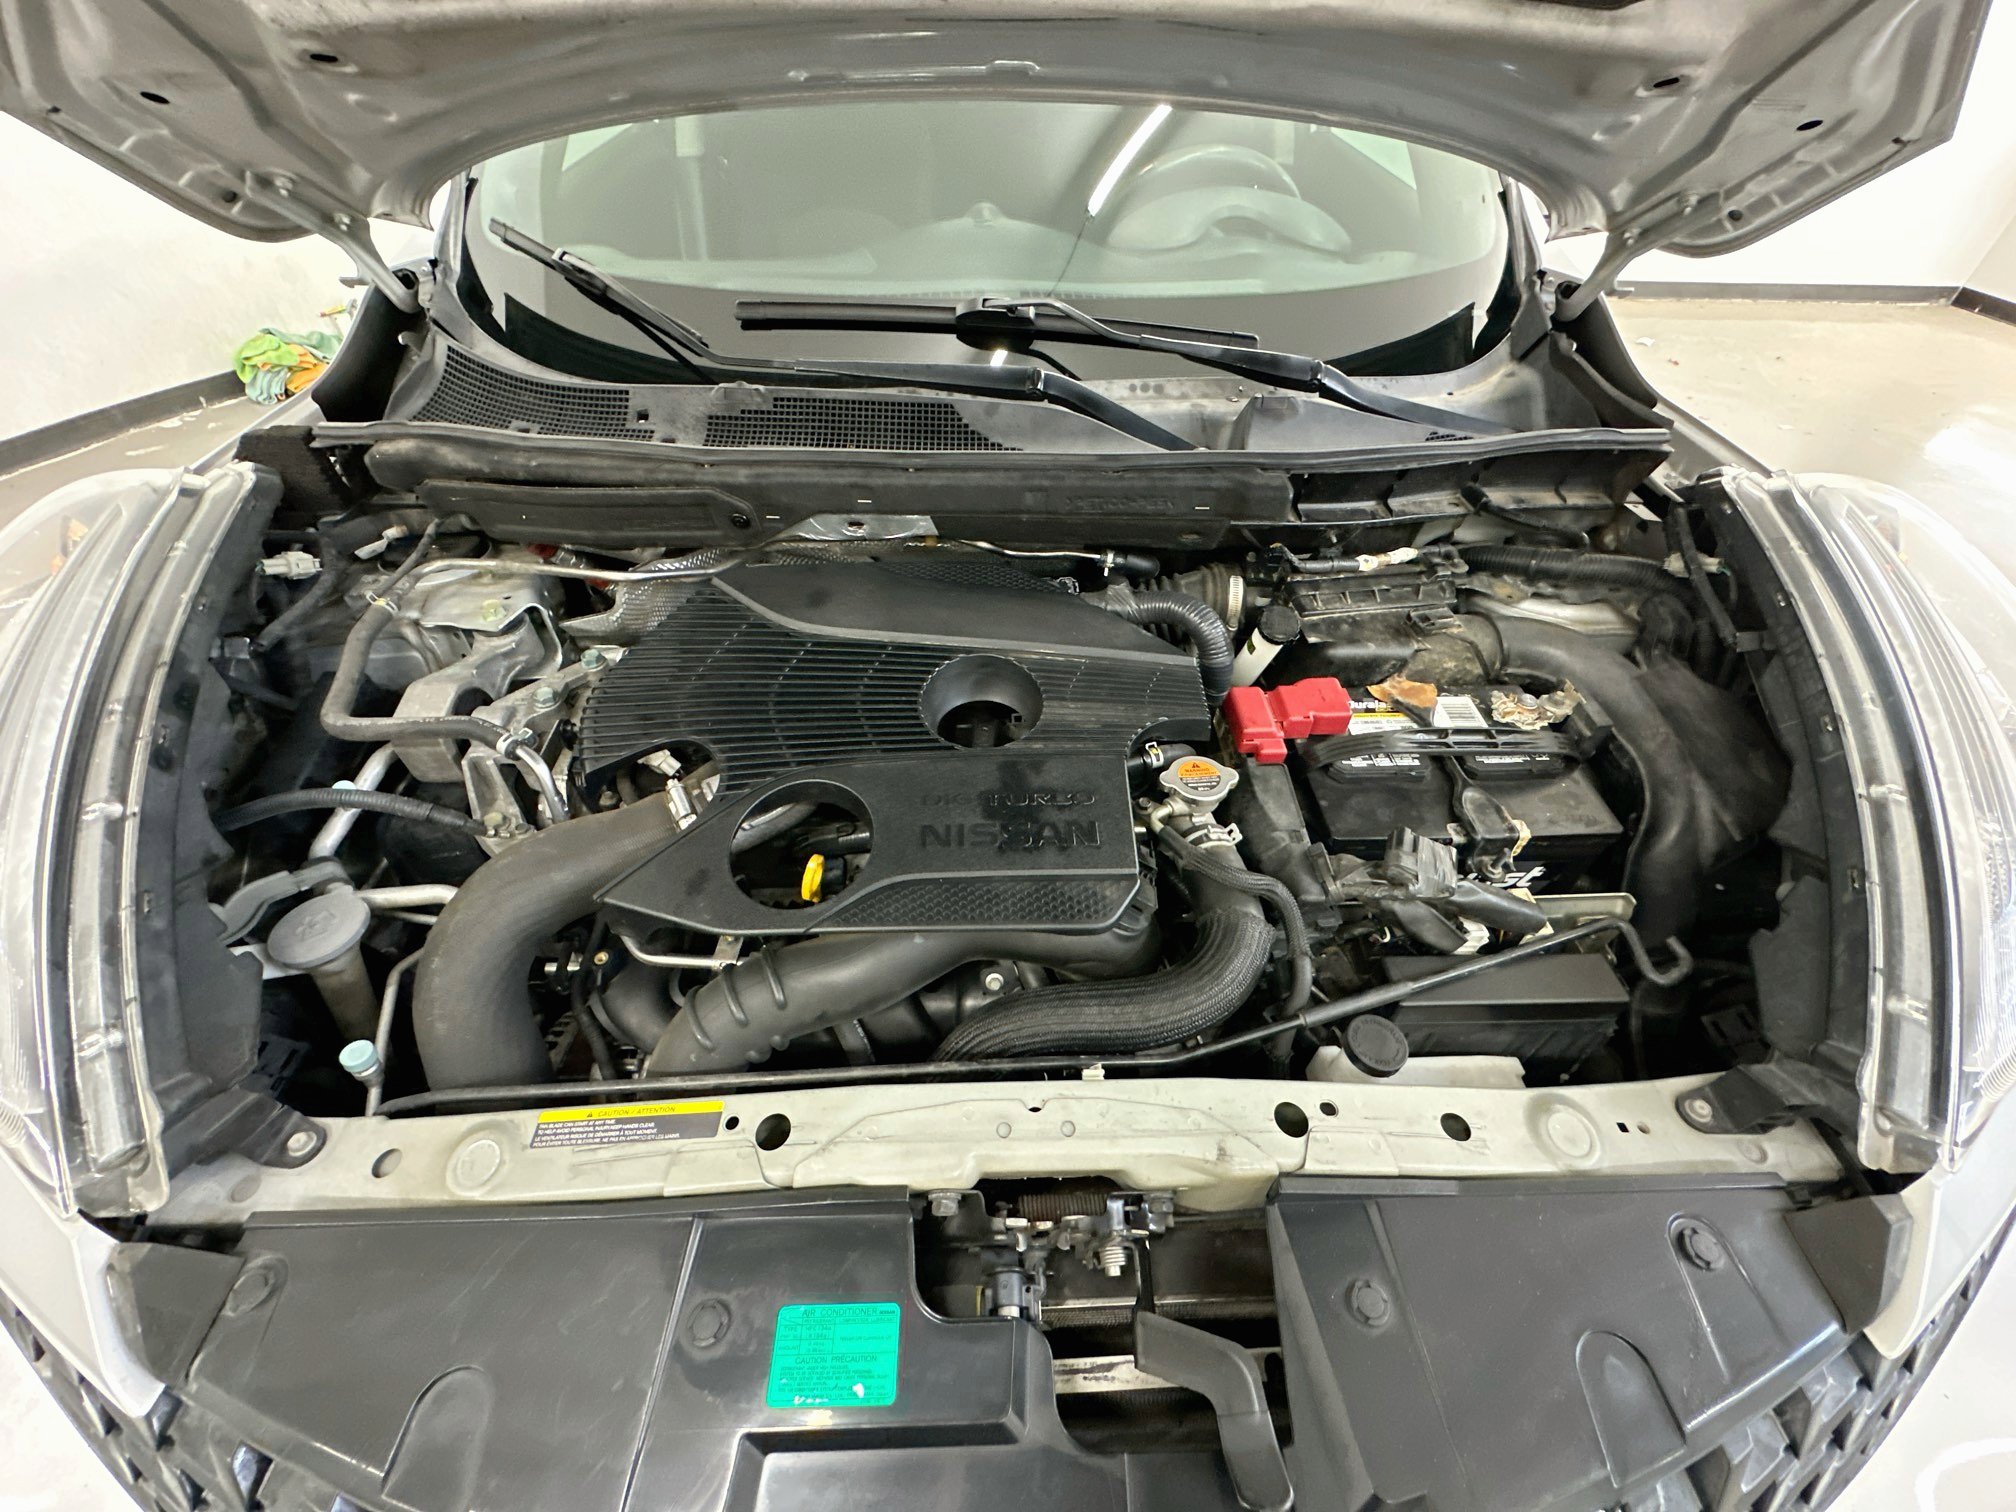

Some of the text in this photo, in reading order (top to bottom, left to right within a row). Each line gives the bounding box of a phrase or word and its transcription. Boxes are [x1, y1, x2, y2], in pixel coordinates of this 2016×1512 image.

[988, 793, 1095, 806] TURBO
[920, 821, 1101, 849] NISSAN
[598, 1109, 629, 1117] CAUTION
[636, 1106, 676, 1114] ATTENTION
[802, 1309, 816, 1317] AIR
[820, 1307, 877, 1316] CONDITIONER
[795, 1354, 878, 1365] CAUTION PRÉCAUTION
